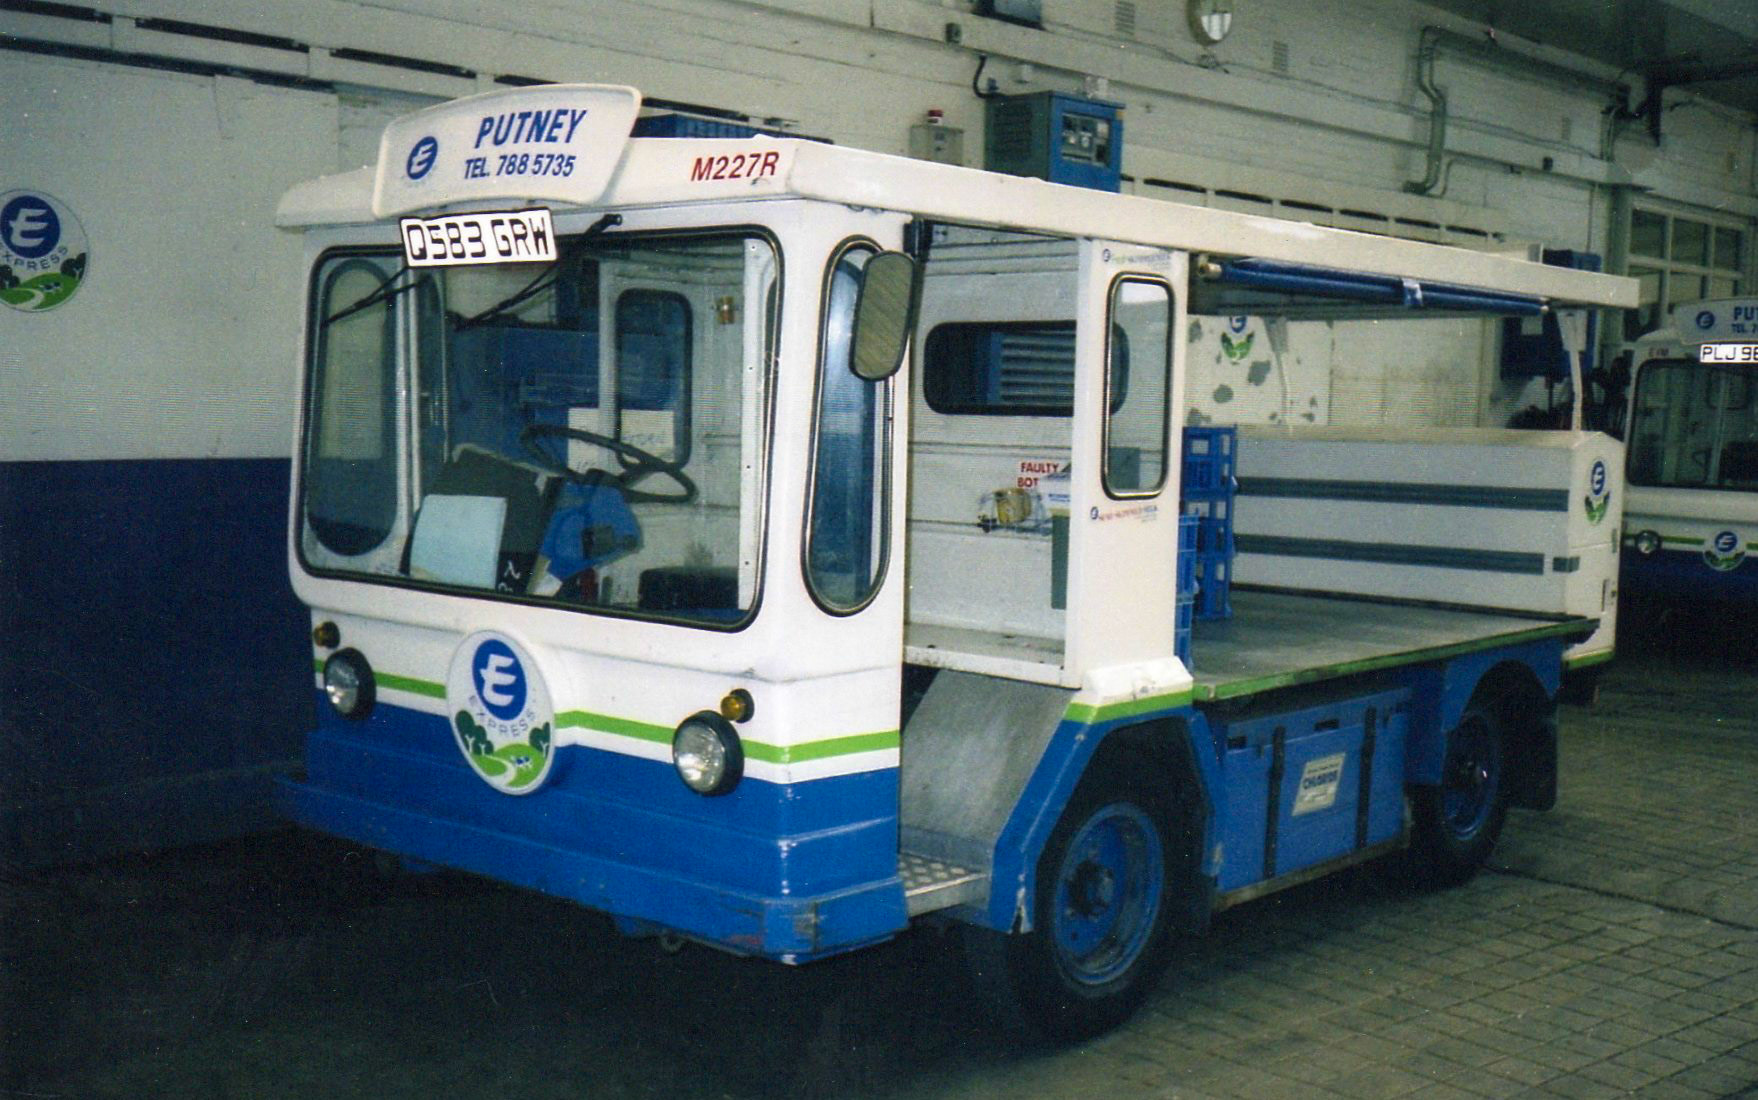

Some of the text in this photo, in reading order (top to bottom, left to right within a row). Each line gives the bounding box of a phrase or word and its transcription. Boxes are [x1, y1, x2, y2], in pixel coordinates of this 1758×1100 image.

[474, 109, 587, 149] PUTNEY
[464, 153, 576, 179] TEL. 788 5735
[691, 151, 780, 182] M227R
[406, 217, 549, 261] Q583 GRW
[1702, 346, 1736, 360] PLJ
[1020, 461, 1060, 474] FAULTY
